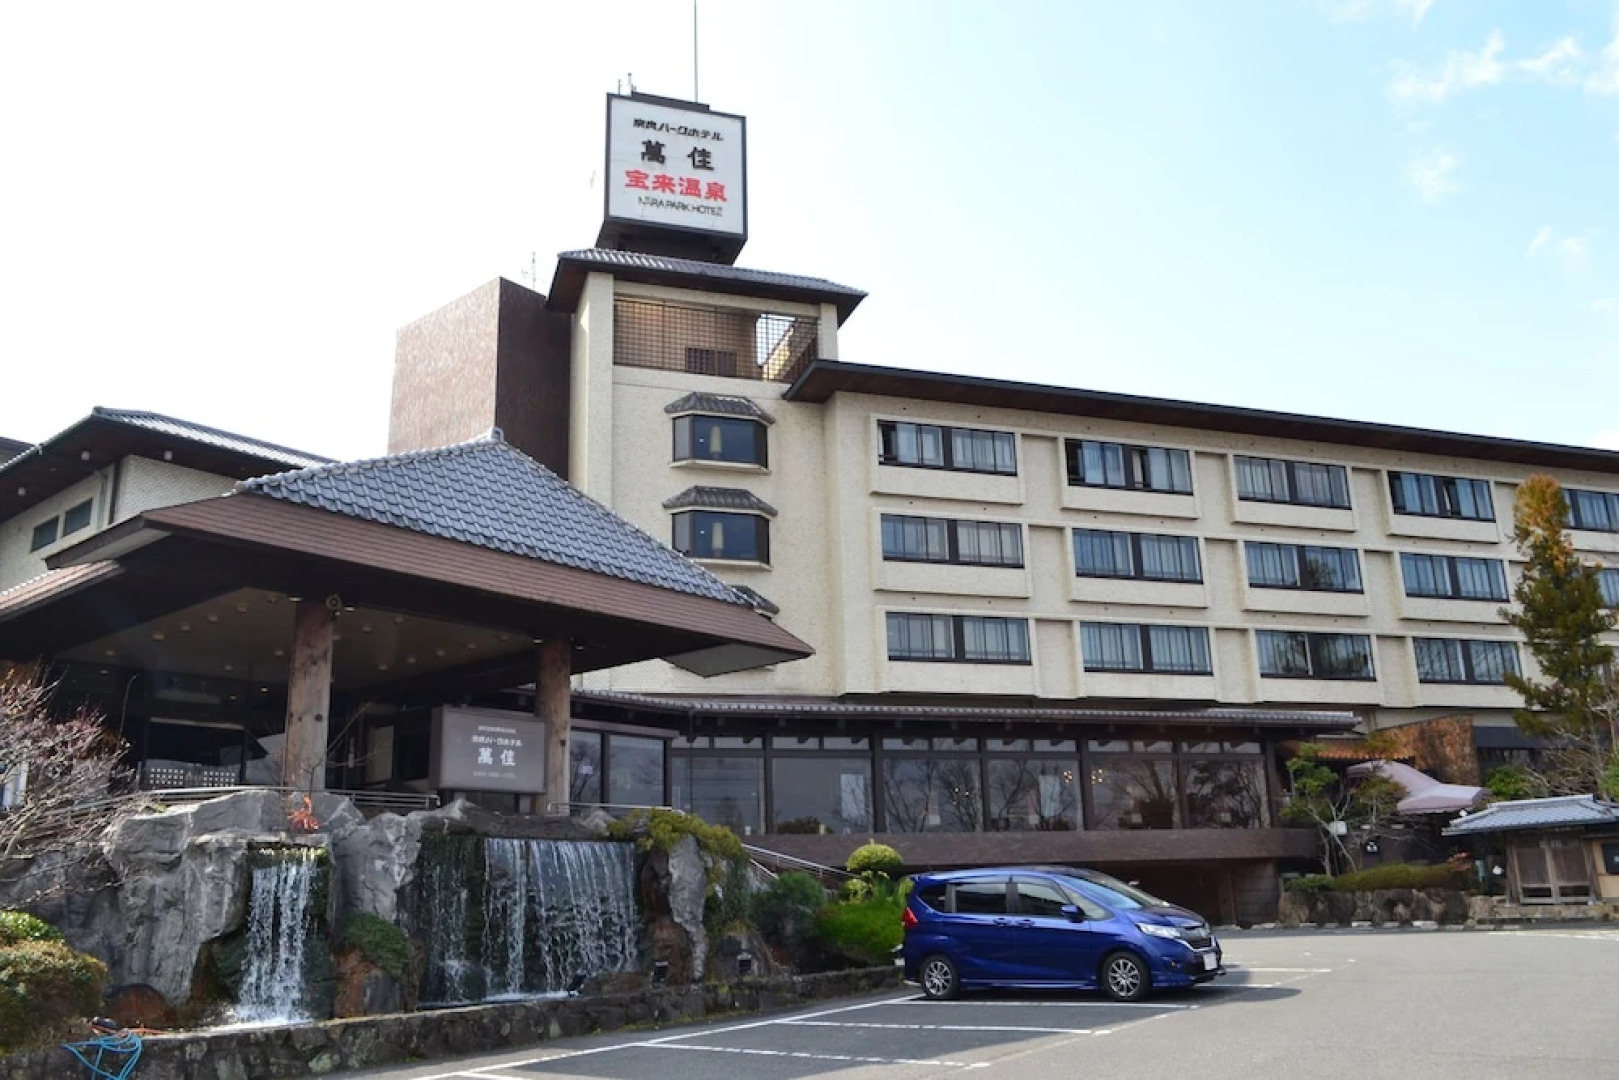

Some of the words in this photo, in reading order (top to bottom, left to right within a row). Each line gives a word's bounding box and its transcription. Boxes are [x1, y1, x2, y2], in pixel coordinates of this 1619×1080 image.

[624, 169, 728, 202] 宝来温泉
[666, 200, 690, 212] PARK
